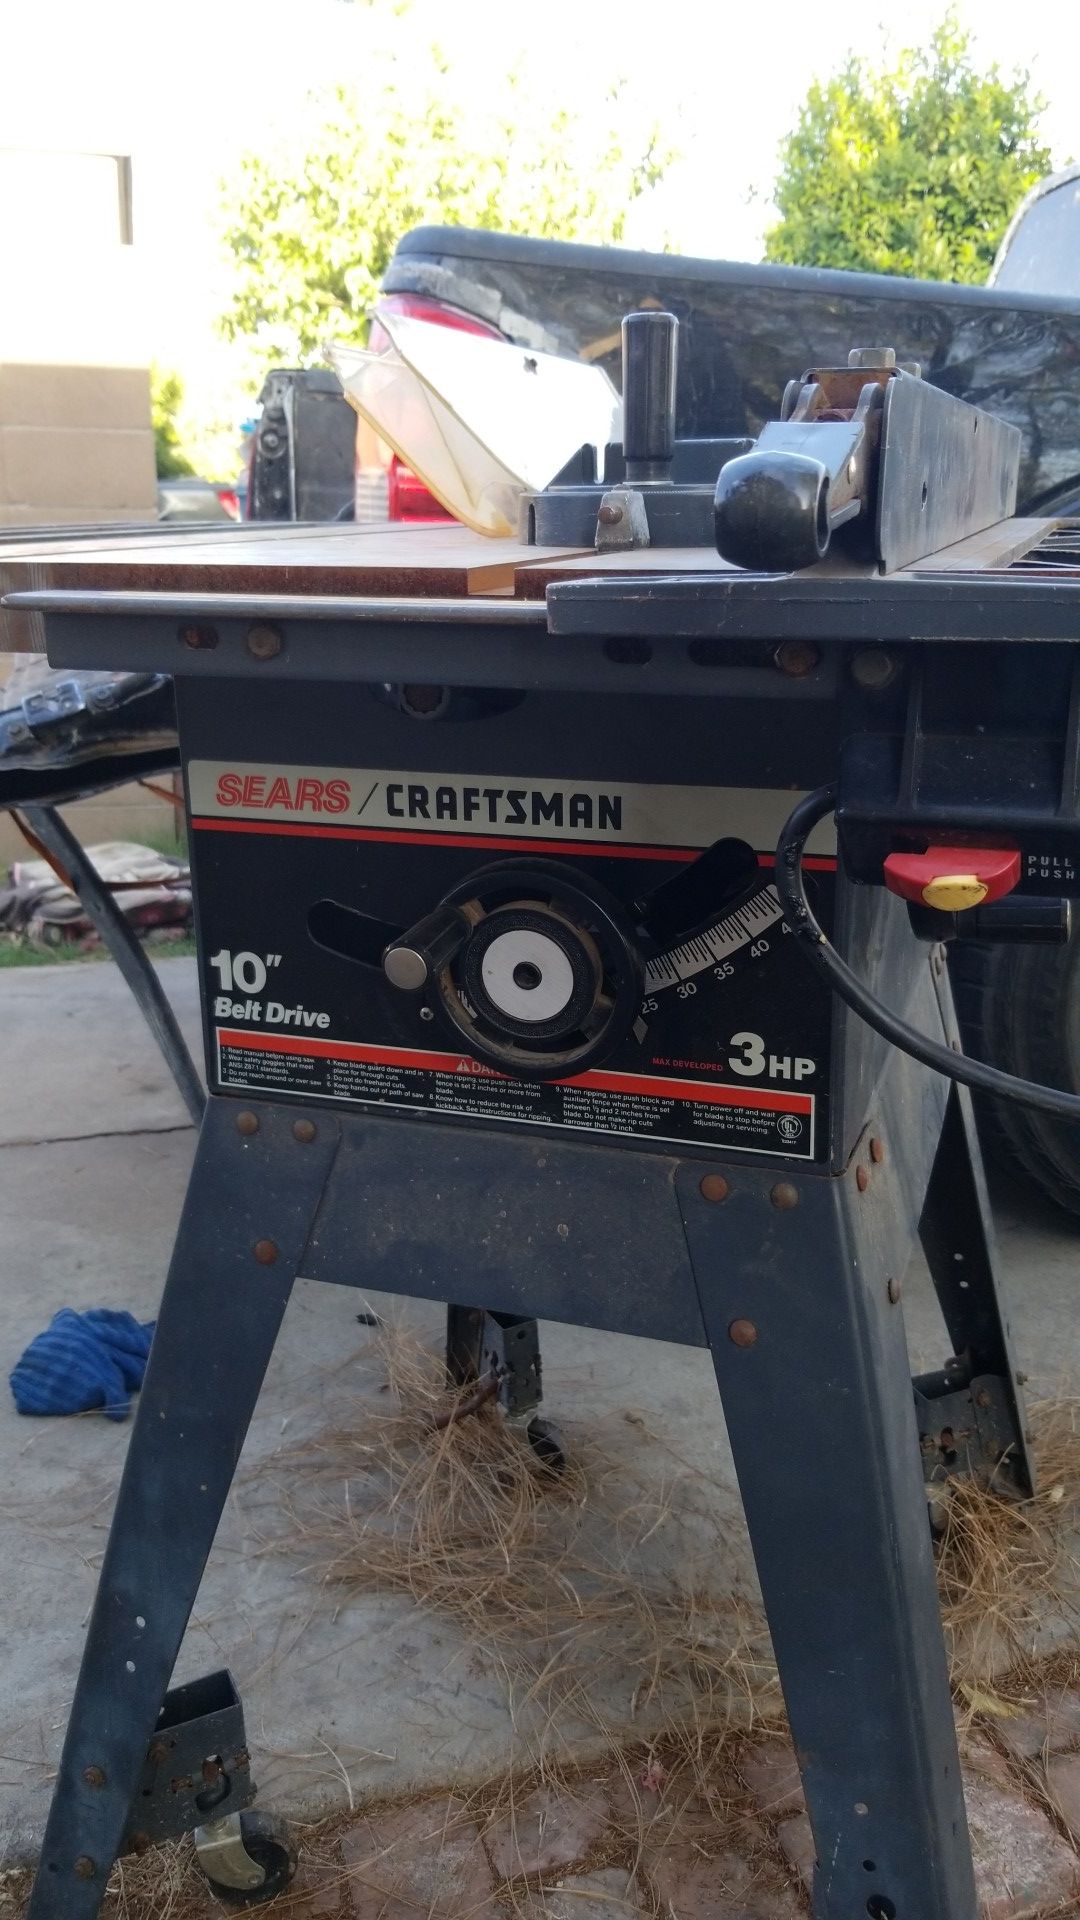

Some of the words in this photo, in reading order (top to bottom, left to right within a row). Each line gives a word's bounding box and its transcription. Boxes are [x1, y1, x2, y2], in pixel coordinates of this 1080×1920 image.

[216, 773, 351, 814] SEARS
[386, 784, 622, 830] CRAFTSMAN
[1028, 856, 1071, 867] PULL
[1028, 868, 1074, 879] PUSH
[781, 921, 793, 934] 4
[750, 940, 770, 958] 40
[714, 962, 734, 980] 35
[676, 982, 697, 998] 30
[215, 997, 262, 1021] Belt
[266, 1002, 330, 1028] Drive
[641, 998, 658, 1014] 25
[245, 1056, 261, 1064] safety
[729, 1032, 765, 1076] 3
[769, 1055, 816, 1080] HP
[653, 1058, 670, 1066] MAX
[673, 1060, 723, 1071] DEVELOPED
[360, 1071, 384, 1079] through
[364, 1079, 390, 1087] freehand
[564, 1096, 590, 1104] auxiliary
[564, 1103, 590, 1111] between
[711, 1105, 731, 1113] power
[480, 1108, 516, 1117] instructions
[529, 1113, 552, 1122] ripping.
[705, 1112, 724, 1120] blade
[735, 1116, 750, 1124] stop
[752, 1118, 775, 1126] before
[564, 1119, 592, 1127] narrower
[694, 1119, 725, 1129] adjusting
